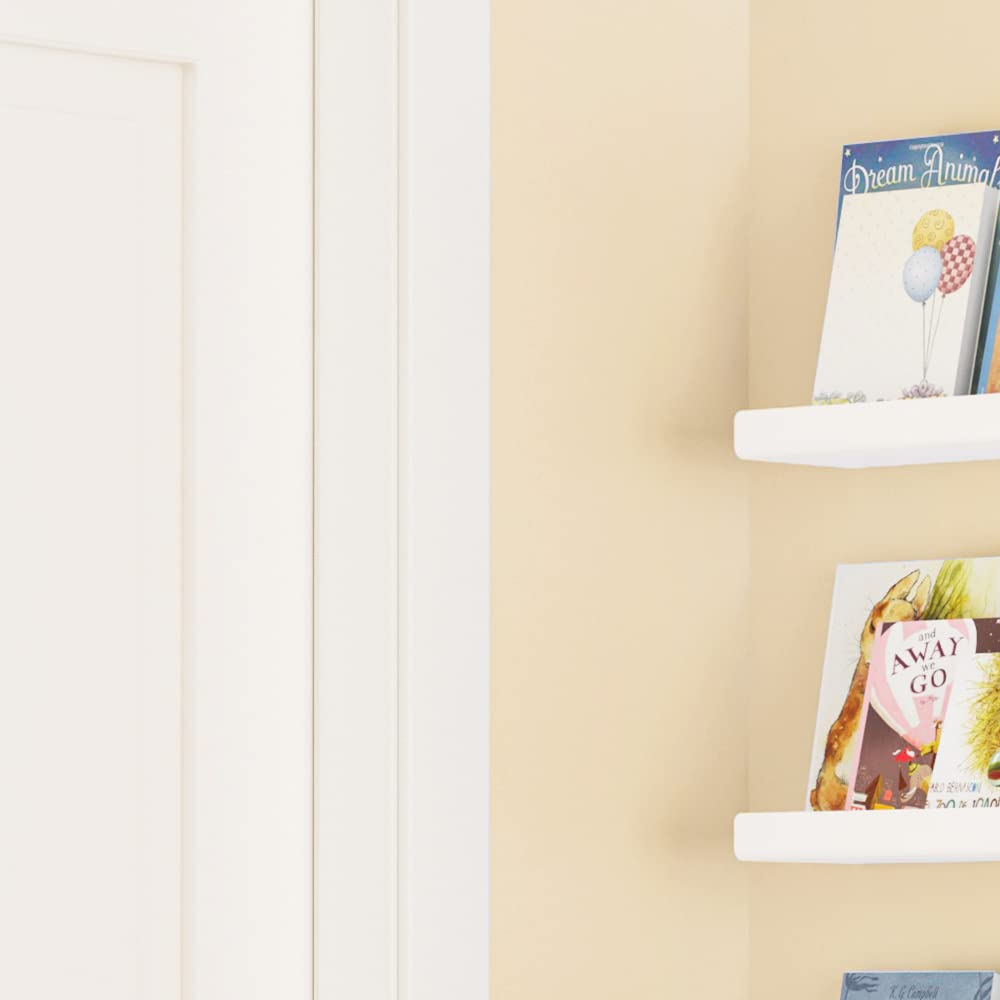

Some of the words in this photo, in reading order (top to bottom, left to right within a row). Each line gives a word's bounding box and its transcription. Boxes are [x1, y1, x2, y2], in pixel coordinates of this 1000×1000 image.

[843, 159, 917, 195] Dream
[918, 627, 936, 642] and
[891, 637, 964, 676] AWAY
[922, 662, 936, 672] we
[910, 668, 947, 694] GO
[907, 984, 940, 1000] Campbell
